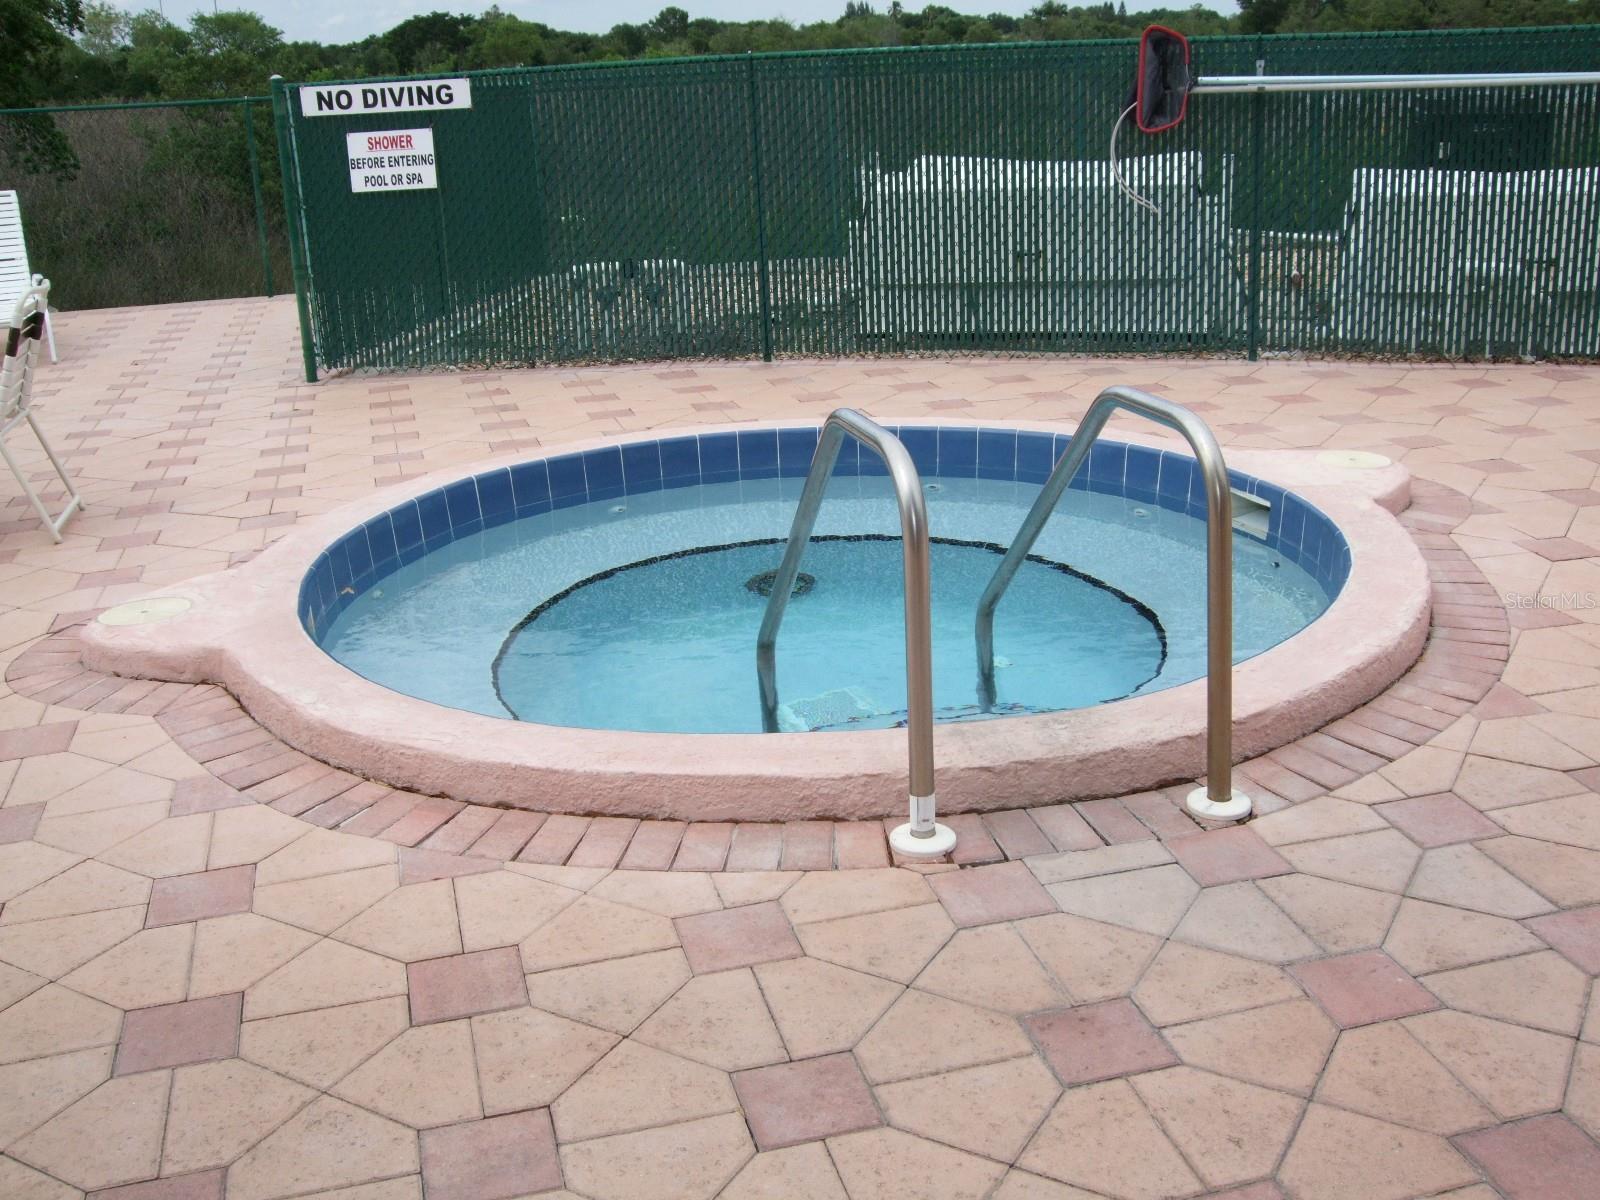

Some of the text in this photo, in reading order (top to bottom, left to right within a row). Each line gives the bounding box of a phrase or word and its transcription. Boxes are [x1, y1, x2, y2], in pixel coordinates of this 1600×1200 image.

[316, 84, 454, 112] NO DIVING
[367, 134, 413, 150] SHOWER
[350, 153, 434, 170] BEFORE ENTERING
[364, 172, 423, 187] POOL OR SPA
